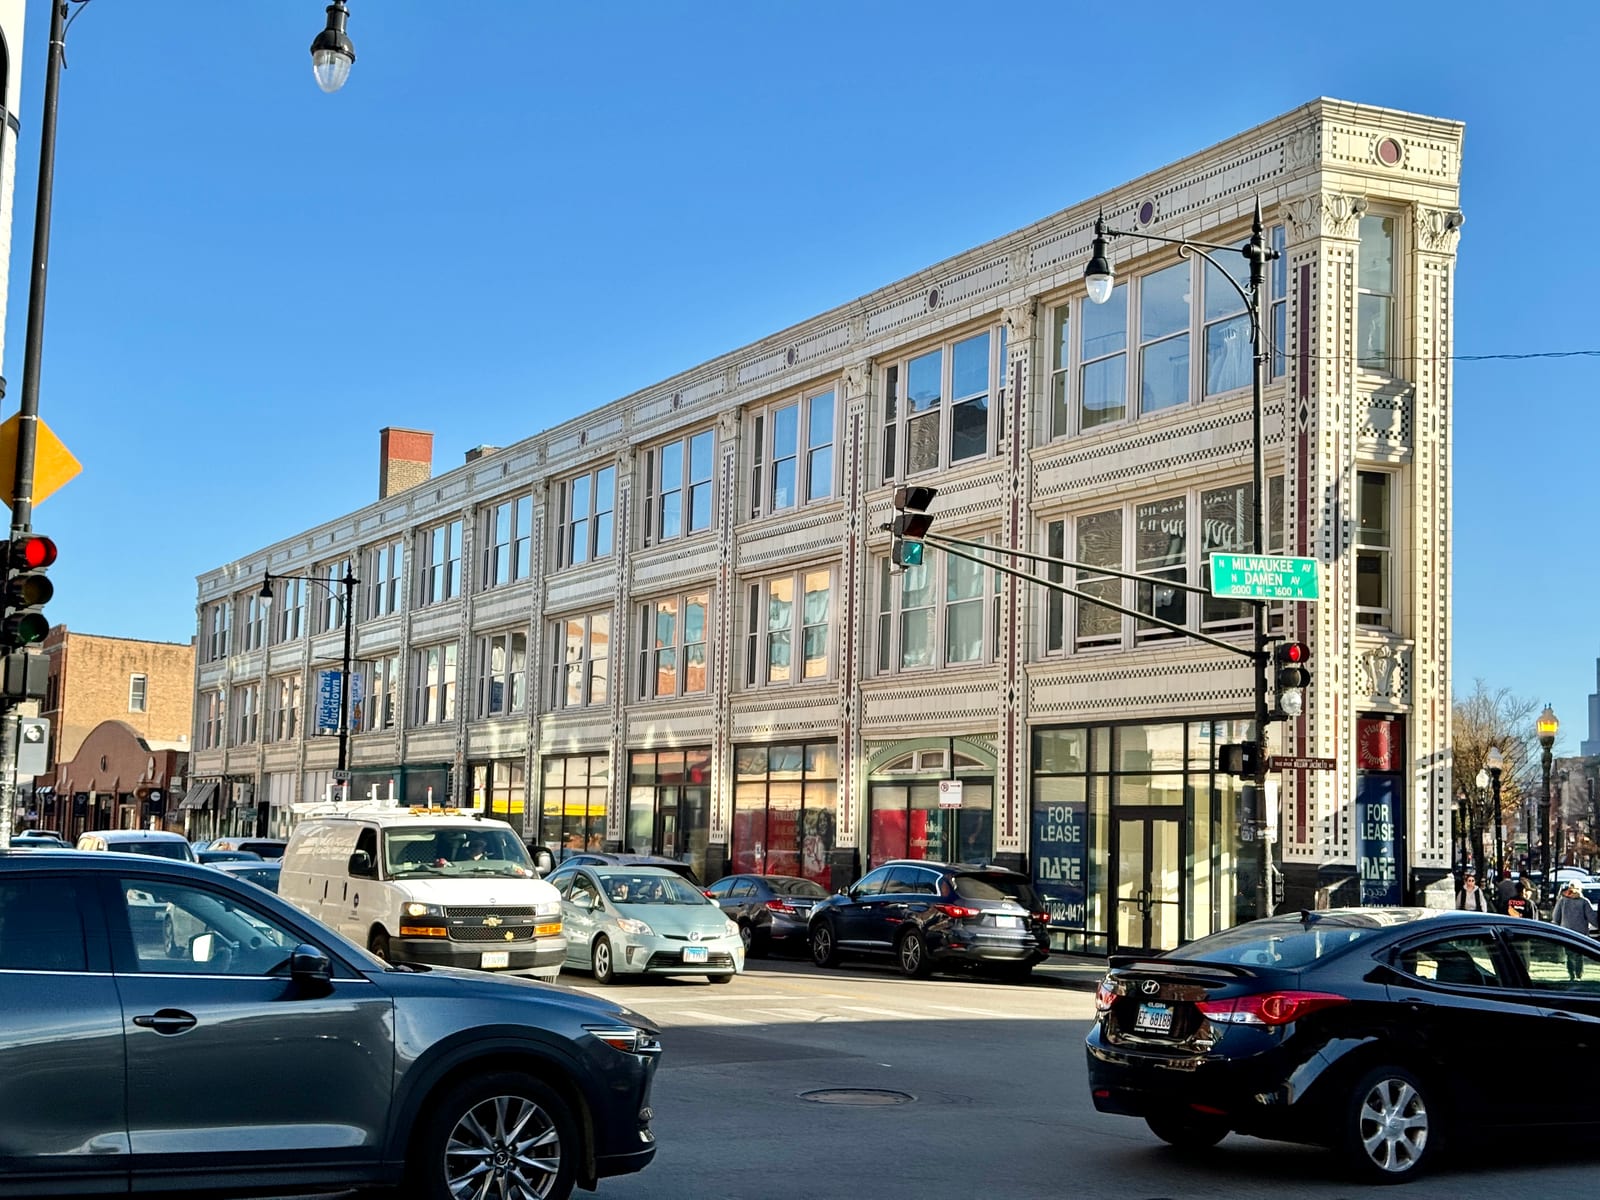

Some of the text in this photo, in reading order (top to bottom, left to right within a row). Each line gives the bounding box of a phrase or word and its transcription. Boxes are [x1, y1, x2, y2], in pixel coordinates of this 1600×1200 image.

[1219, 558, 1312, 573] N MILWAUKEE AV
[1231, 572, 1300, 586] N DAMEN AV
[1274, 587, 1293, 596] 1600
[1048, 806, 1073, 824] FOR
[1367, 803, 1389, 822] FOR
[1040, 825, 1081, 842] LEASE
[1361, 822, 1395, 841] LEASE
